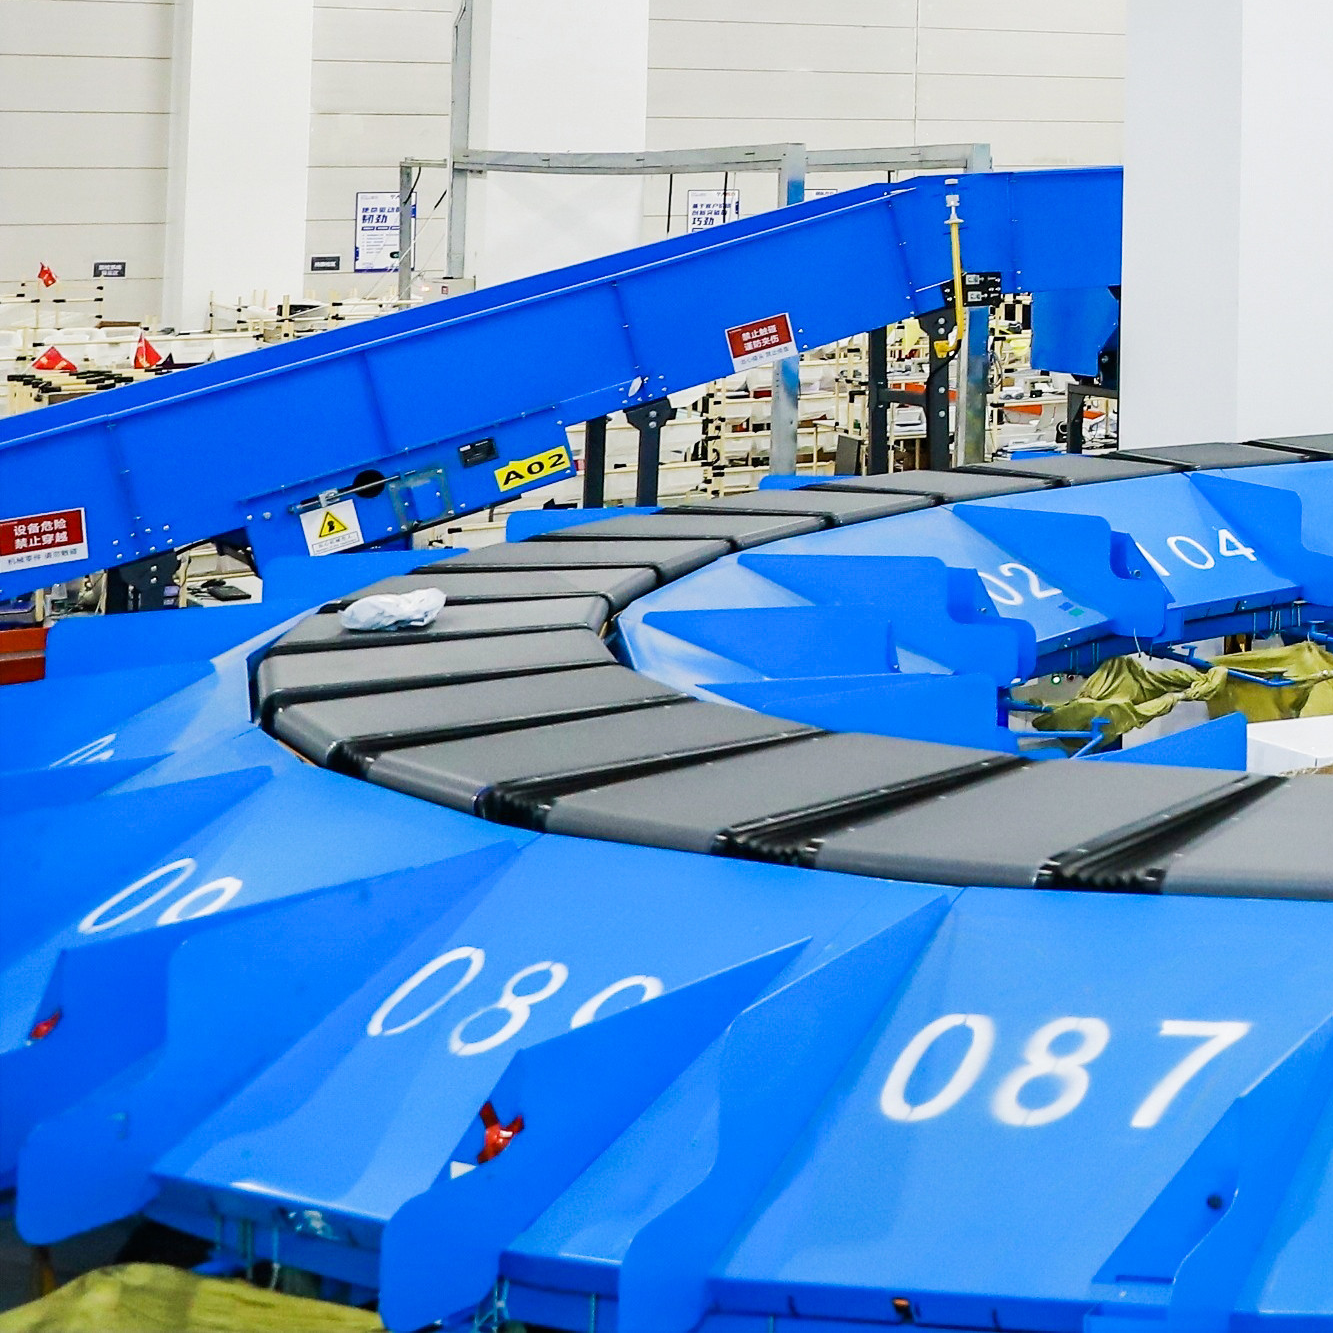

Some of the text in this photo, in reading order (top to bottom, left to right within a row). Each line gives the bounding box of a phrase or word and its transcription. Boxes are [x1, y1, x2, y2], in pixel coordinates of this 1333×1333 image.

[503, 453, 565, 486] A02
[13, 518, 67, 537] 设备危险
[15, 531, 68, 550] 禁止穿越
[1136, 528, 1257, 577] 104
[881, 1013, 1252, 1129] 087
